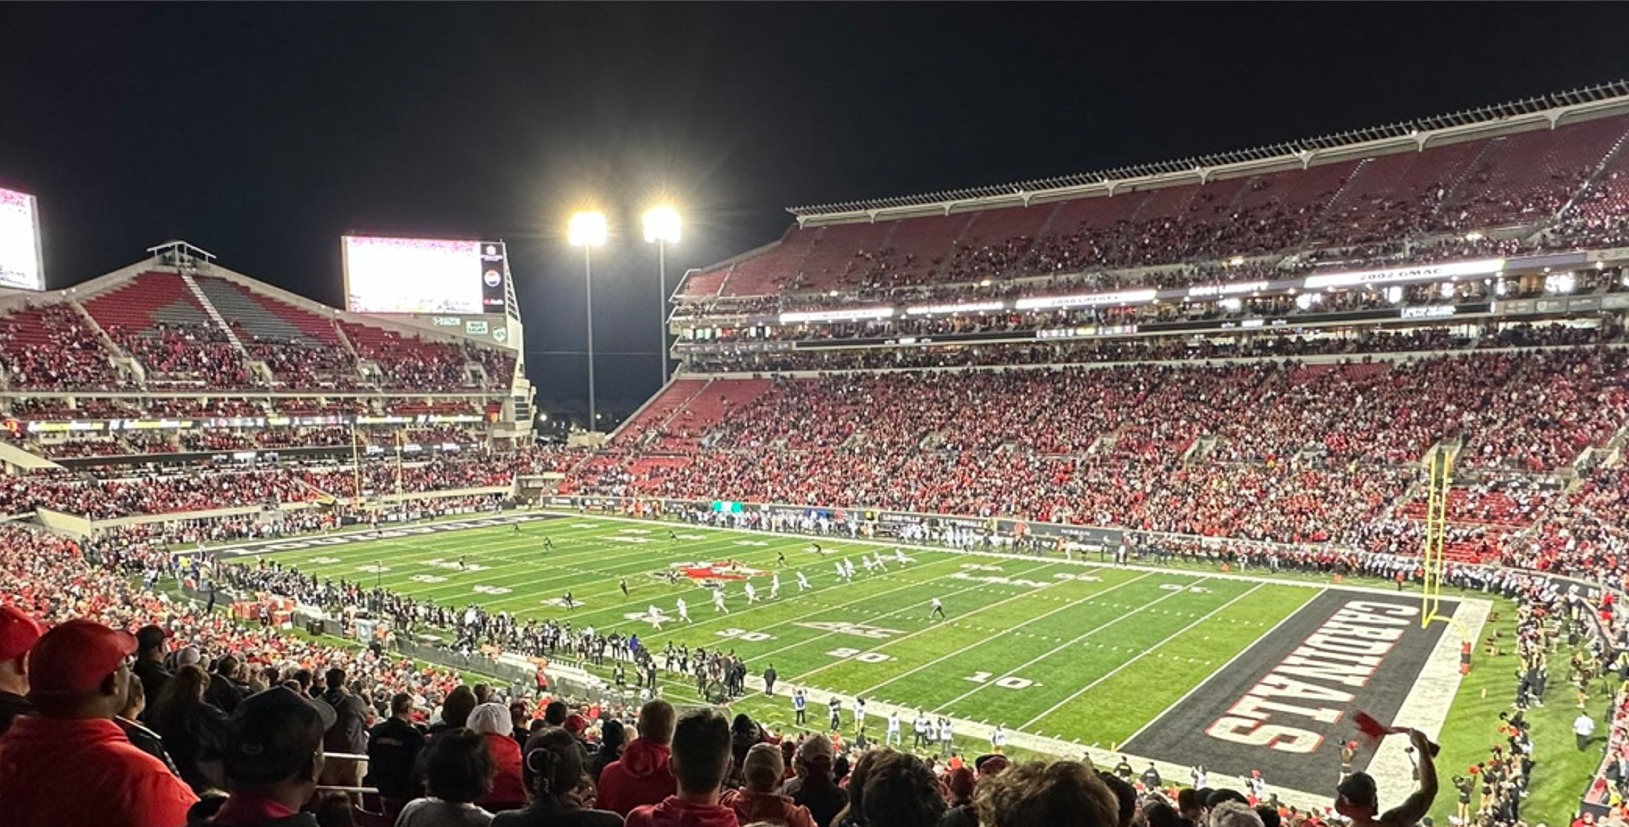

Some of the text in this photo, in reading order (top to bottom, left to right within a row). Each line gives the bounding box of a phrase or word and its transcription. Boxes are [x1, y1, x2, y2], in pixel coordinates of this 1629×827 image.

[1360, 267, 1443, 281] 2002 GMAC
[1060, 528, 1092, 536] NISSAN
[962, 671, 1034, 690] 10
[1203, 600, 1421, 755] CARDINALS
